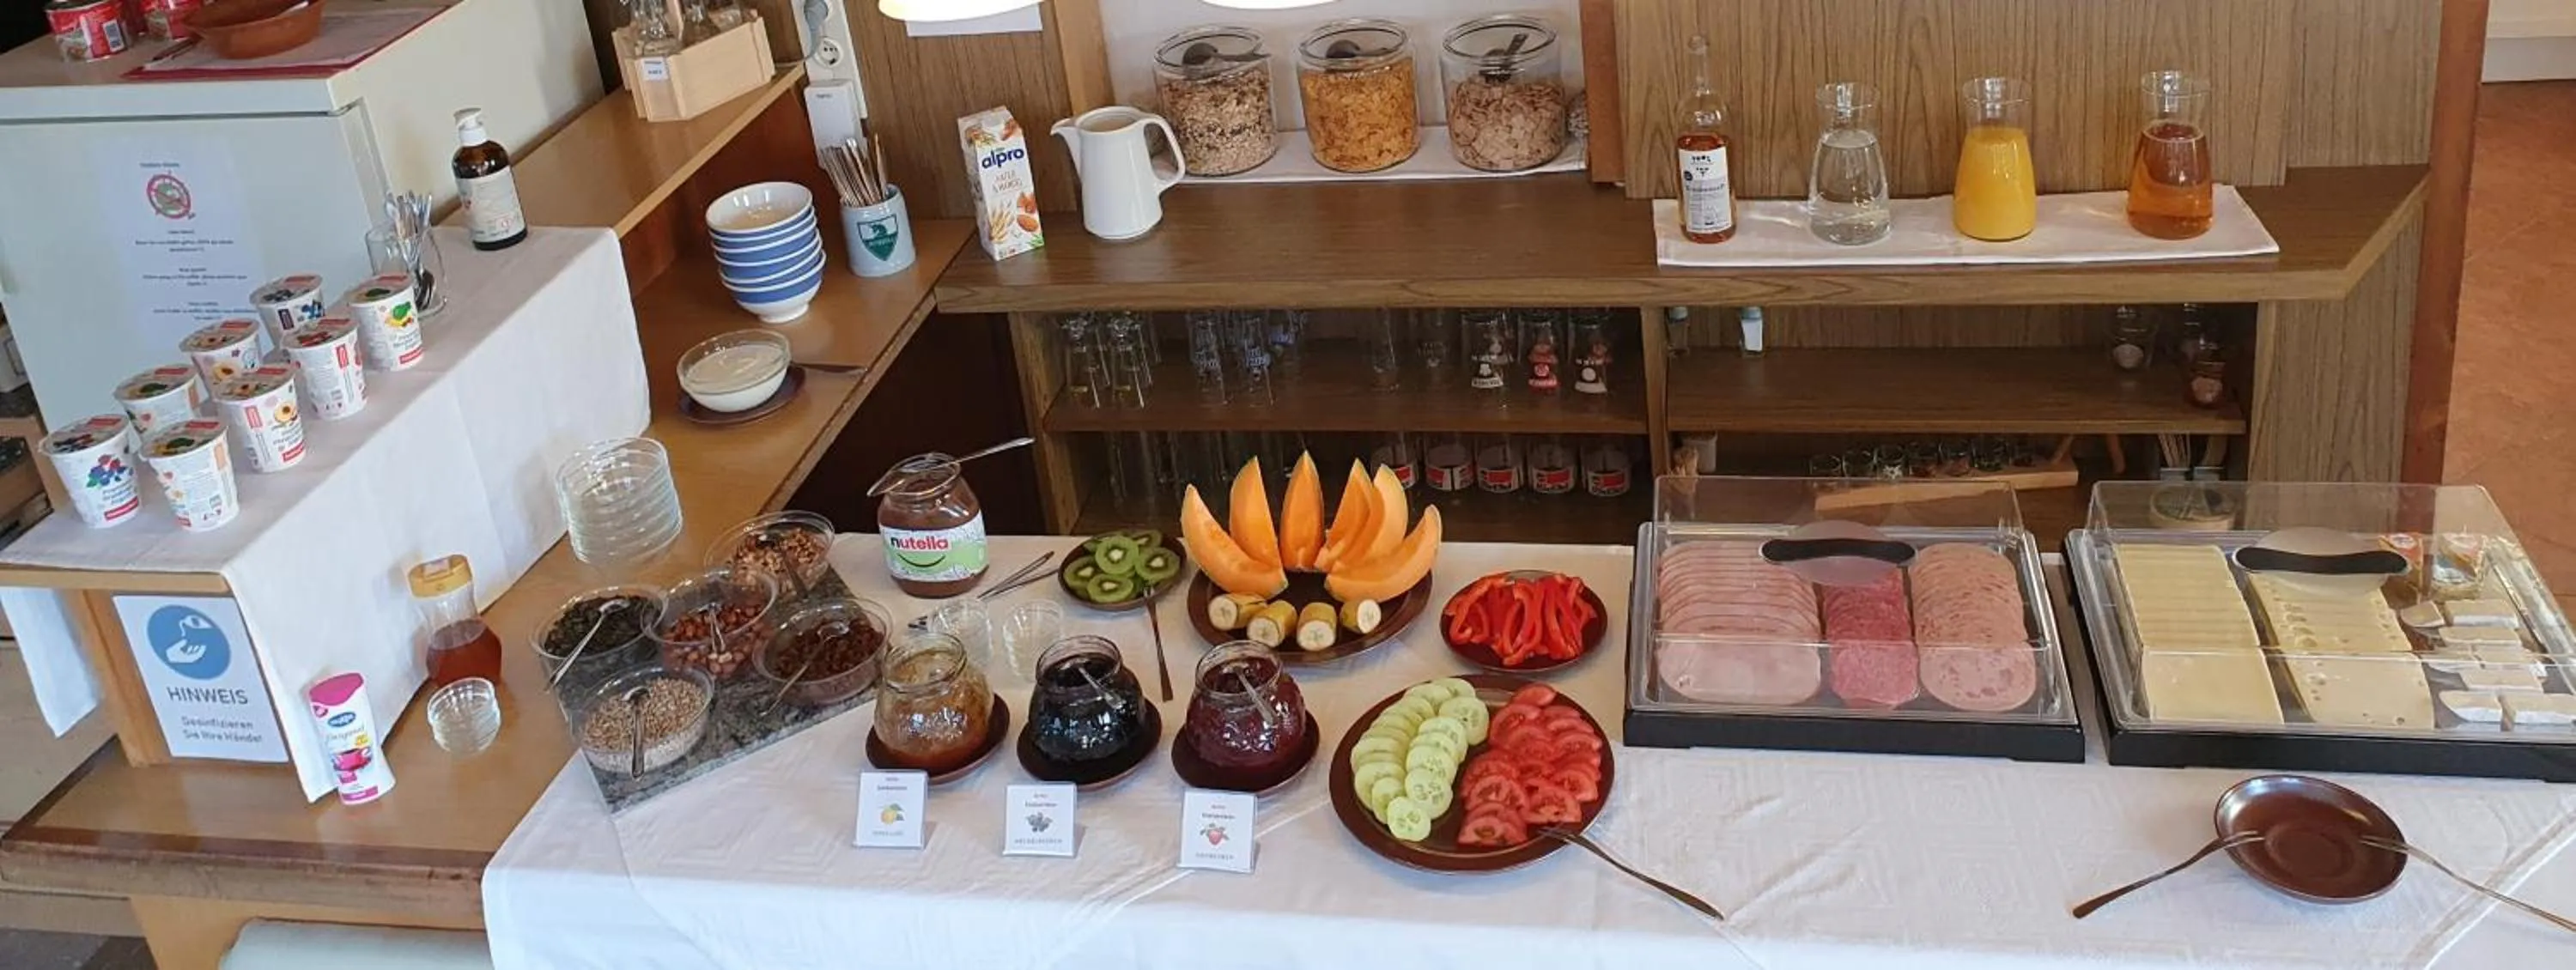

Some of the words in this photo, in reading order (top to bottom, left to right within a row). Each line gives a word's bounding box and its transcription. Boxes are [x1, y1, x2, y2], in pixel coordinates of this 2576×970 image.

[981, 149, 1024, 168] alpro
[890, 536, 949, 549] nutella
[166, 686, 248, 705] HINWEIS
[181, 715, 253, 730] Desinfizieren
[183, 729, 199, 739] Sie
[201, 730, 222, 740] Ihre
